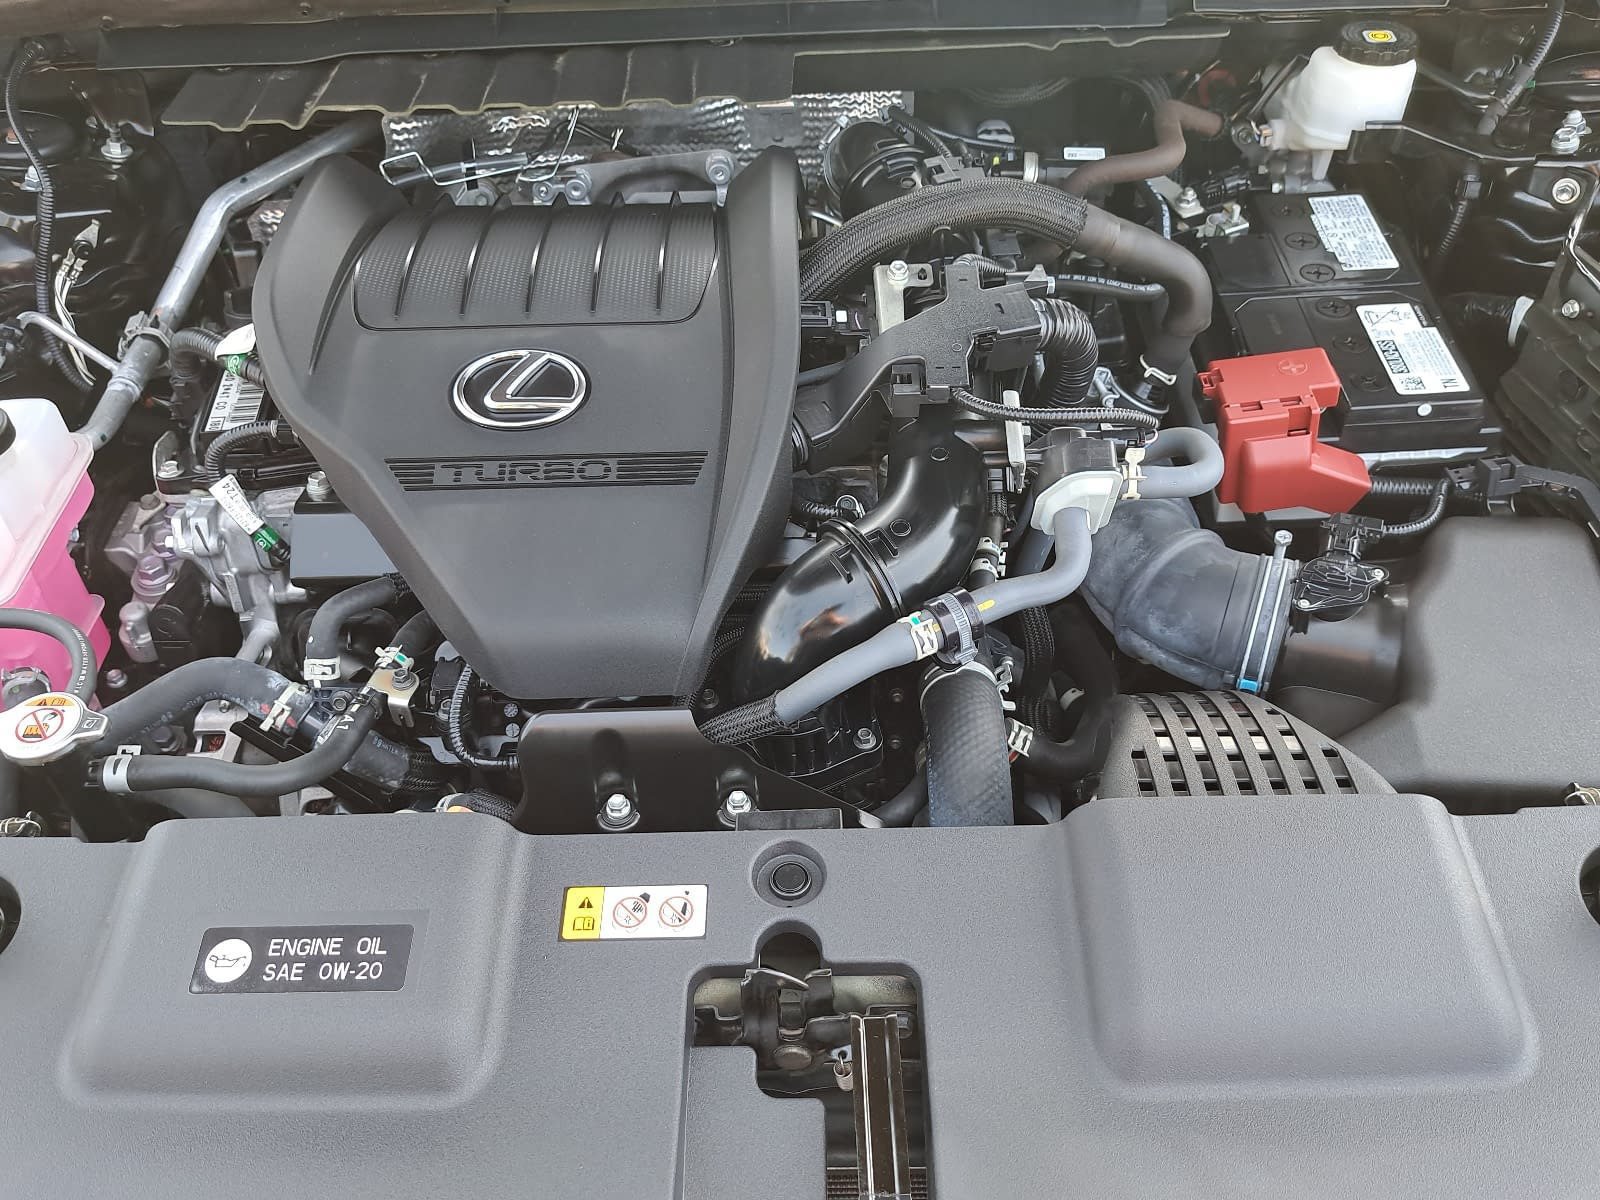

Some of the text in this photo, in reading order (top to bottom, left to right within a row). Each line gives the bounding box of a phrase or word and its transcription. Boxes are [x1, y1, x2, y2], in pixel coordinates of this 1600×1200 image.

[438, 459, 612, 483] TURBO
[268, 937, 387, 957] ENGINE OIL
[262, 962, 383, 981] SAE 0W-20
